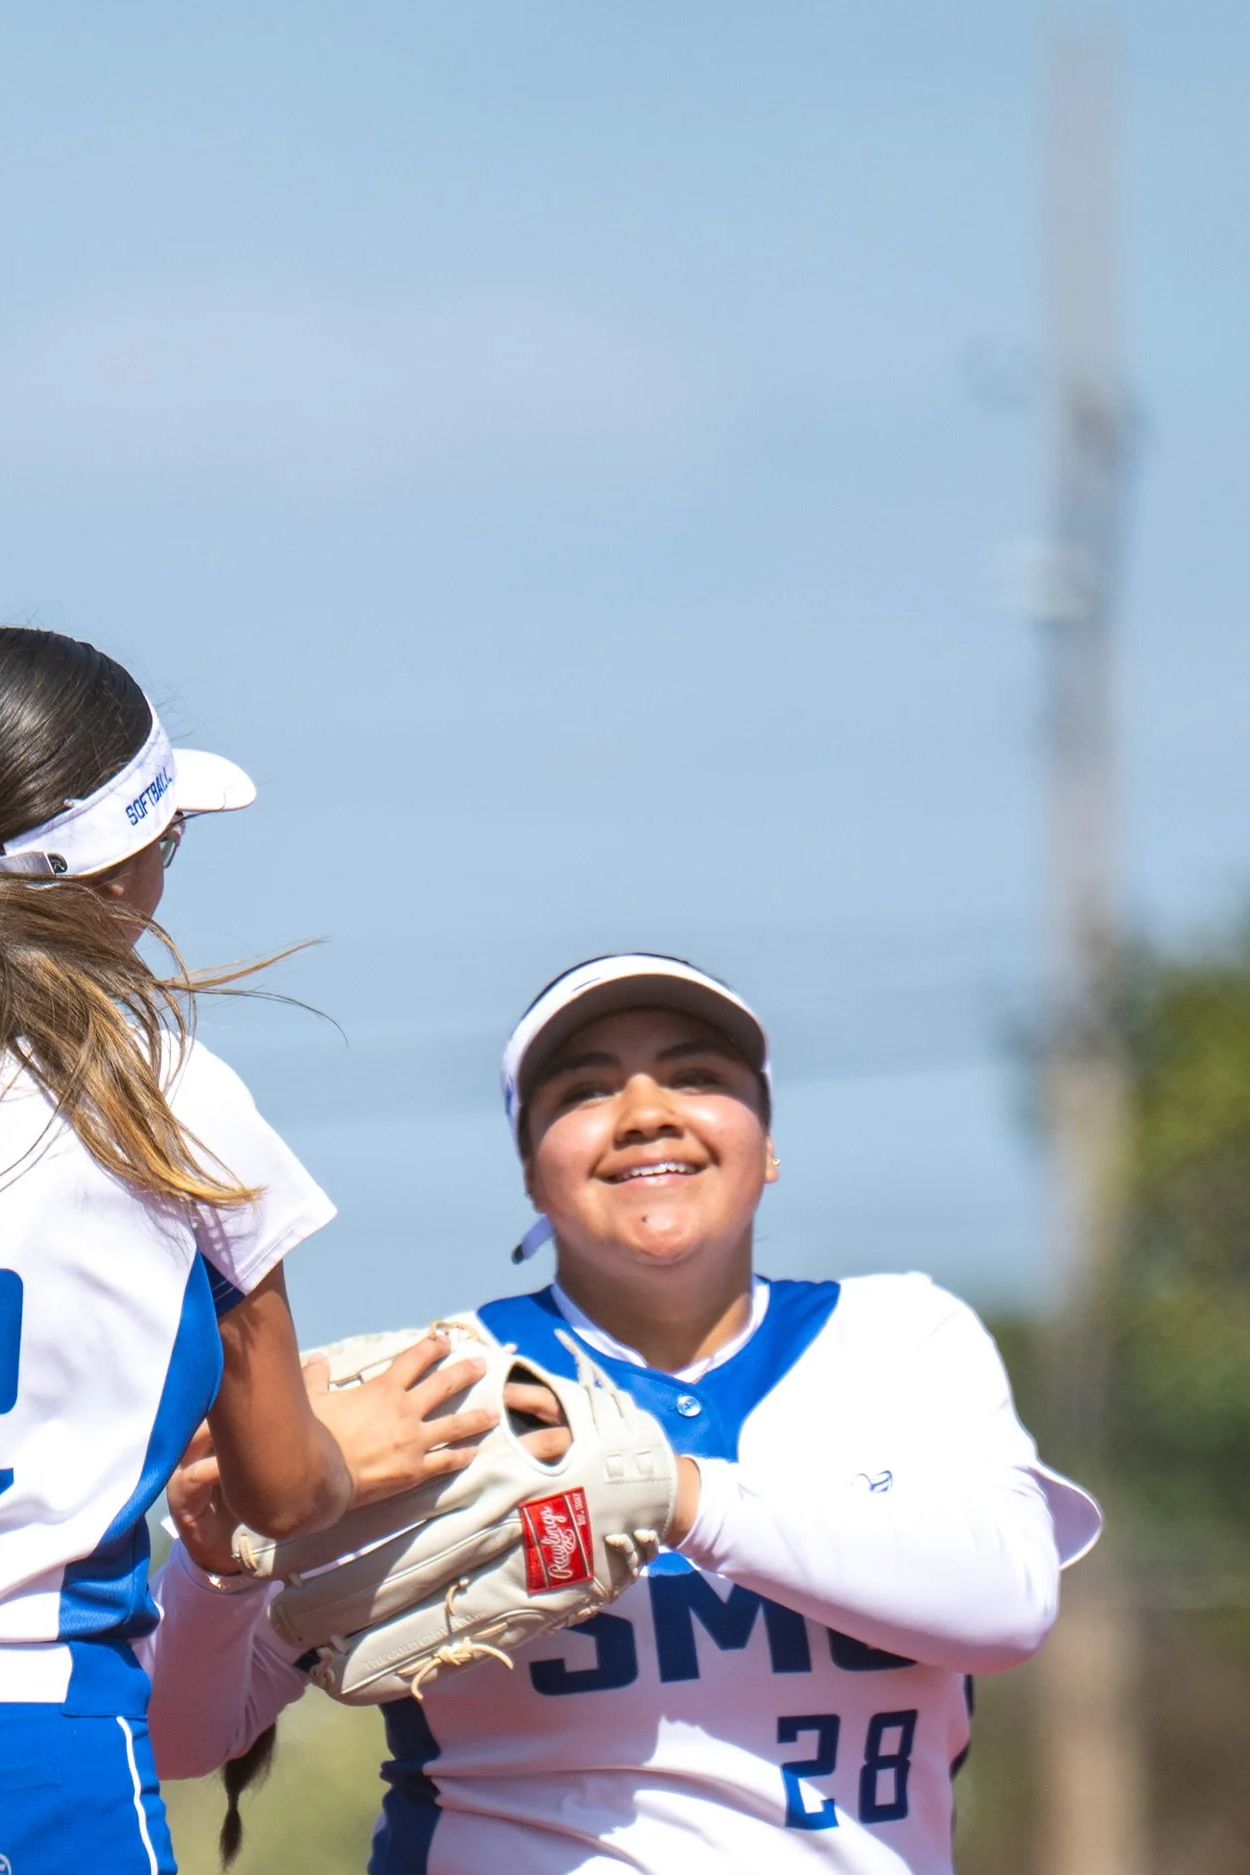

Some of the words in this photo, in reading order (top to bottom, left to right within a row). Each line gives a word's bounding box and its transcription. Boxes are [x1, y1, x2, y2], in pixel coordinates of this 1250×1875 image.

[125, 766, 172, 826] SOFTBALL
[540, 1505, 575, 1580] Rawlings
[776, 1708, 919, 1830] 28
